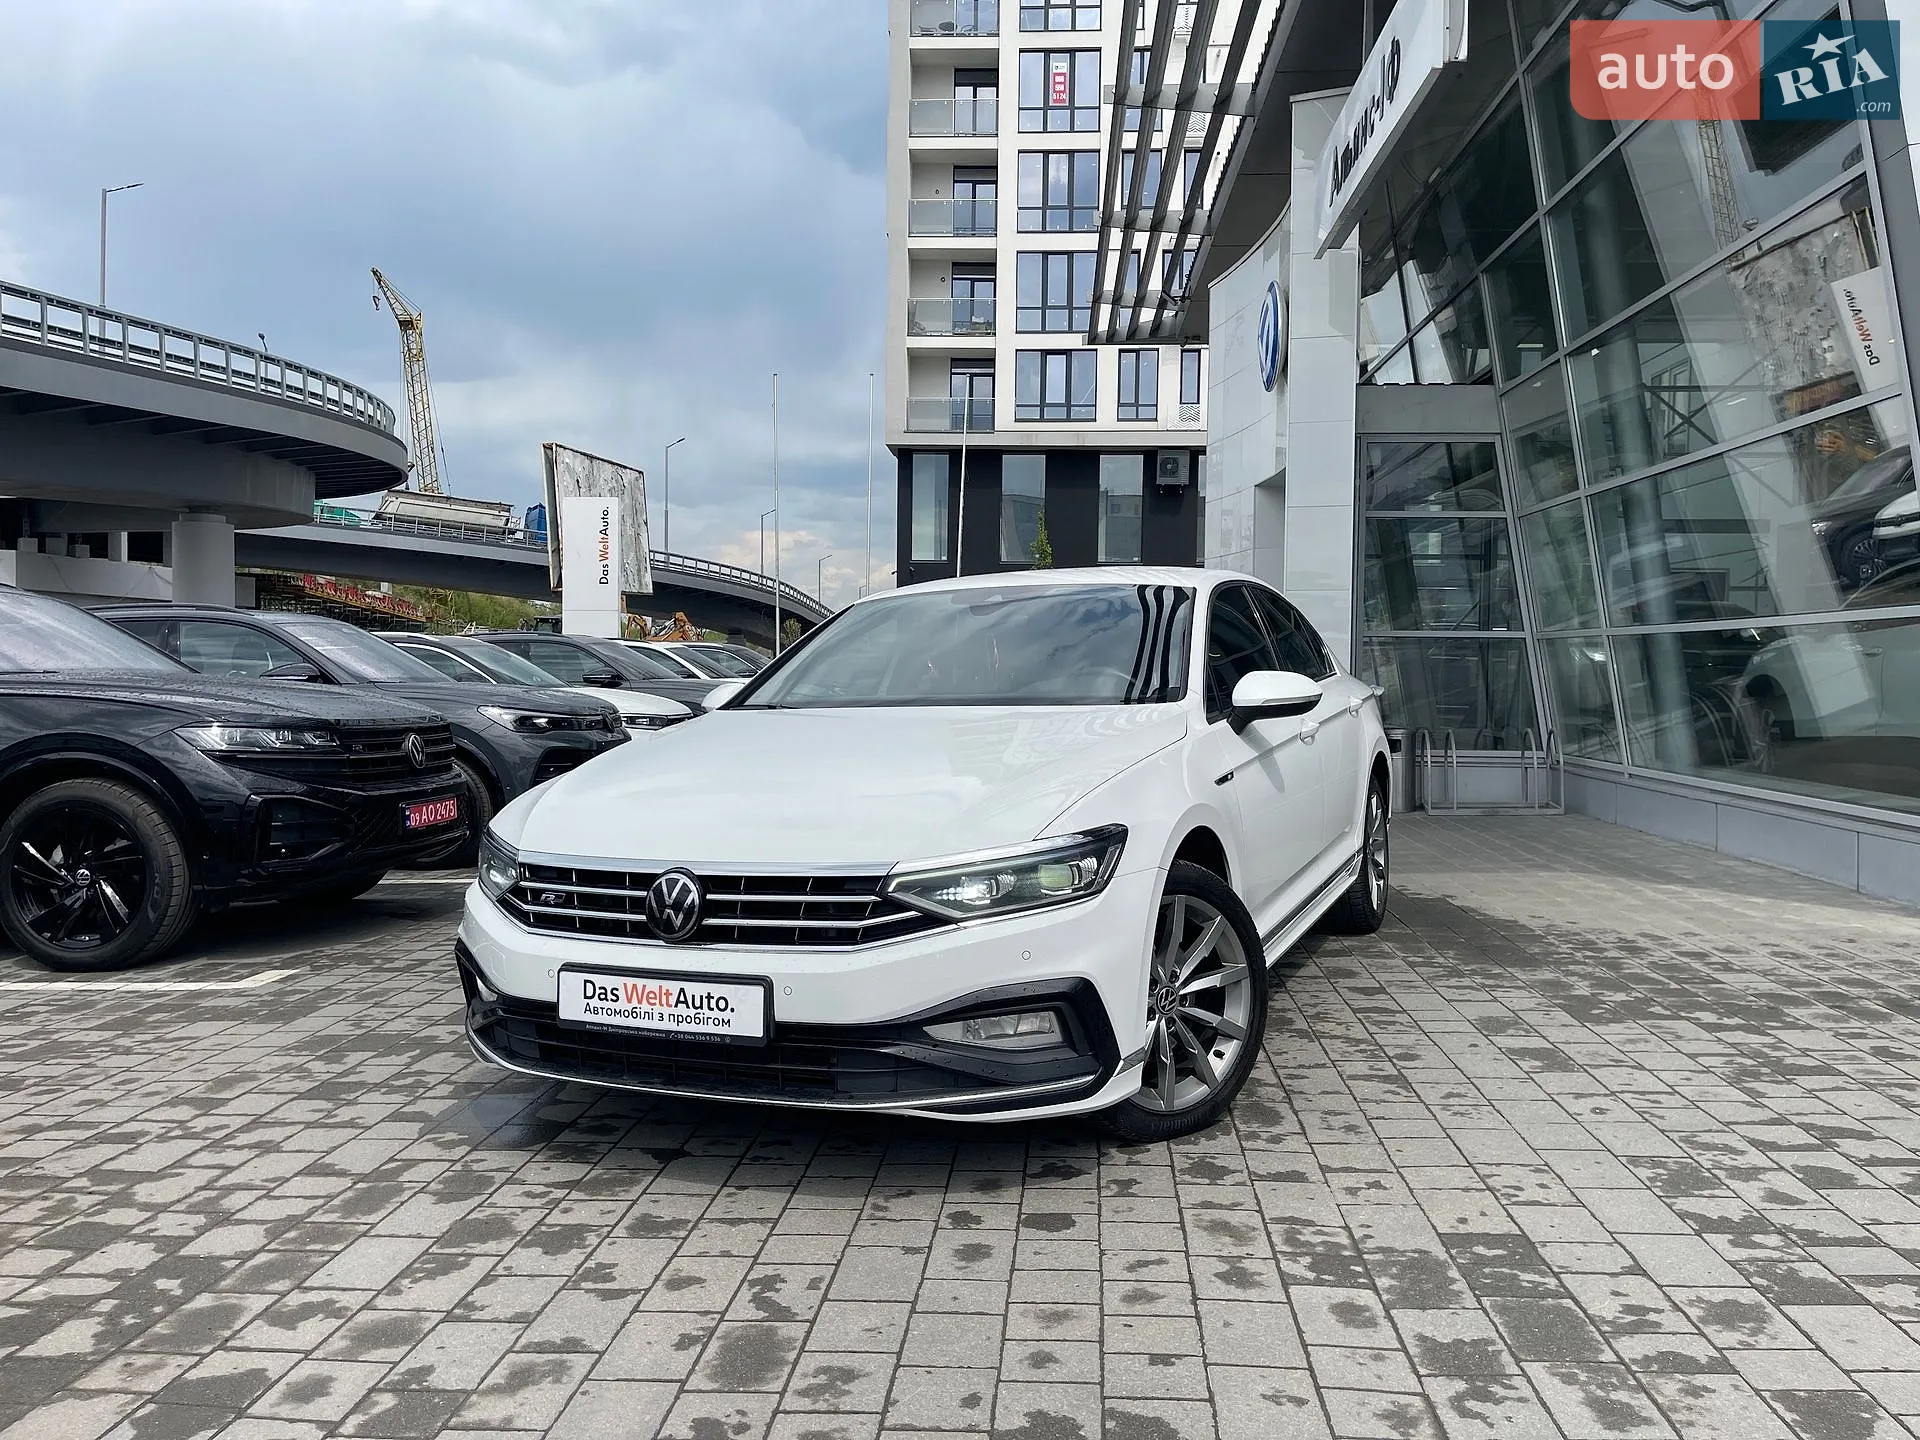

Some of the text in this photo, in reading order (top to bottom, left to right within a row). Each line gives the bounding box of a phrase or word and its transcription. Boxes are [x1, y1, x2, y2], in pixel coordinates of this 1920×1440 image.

[599, 506, 609, 585] Das WeltAuto.
[410, 813, 420, 826] 09
[421, 804, 435, 824] AO
[436, 800, 455, 820] 2475
[583, 979, 736, 1014] Das WeltAuto.
[584, 1002, 731, 1028] Автомобілі з пробігом
